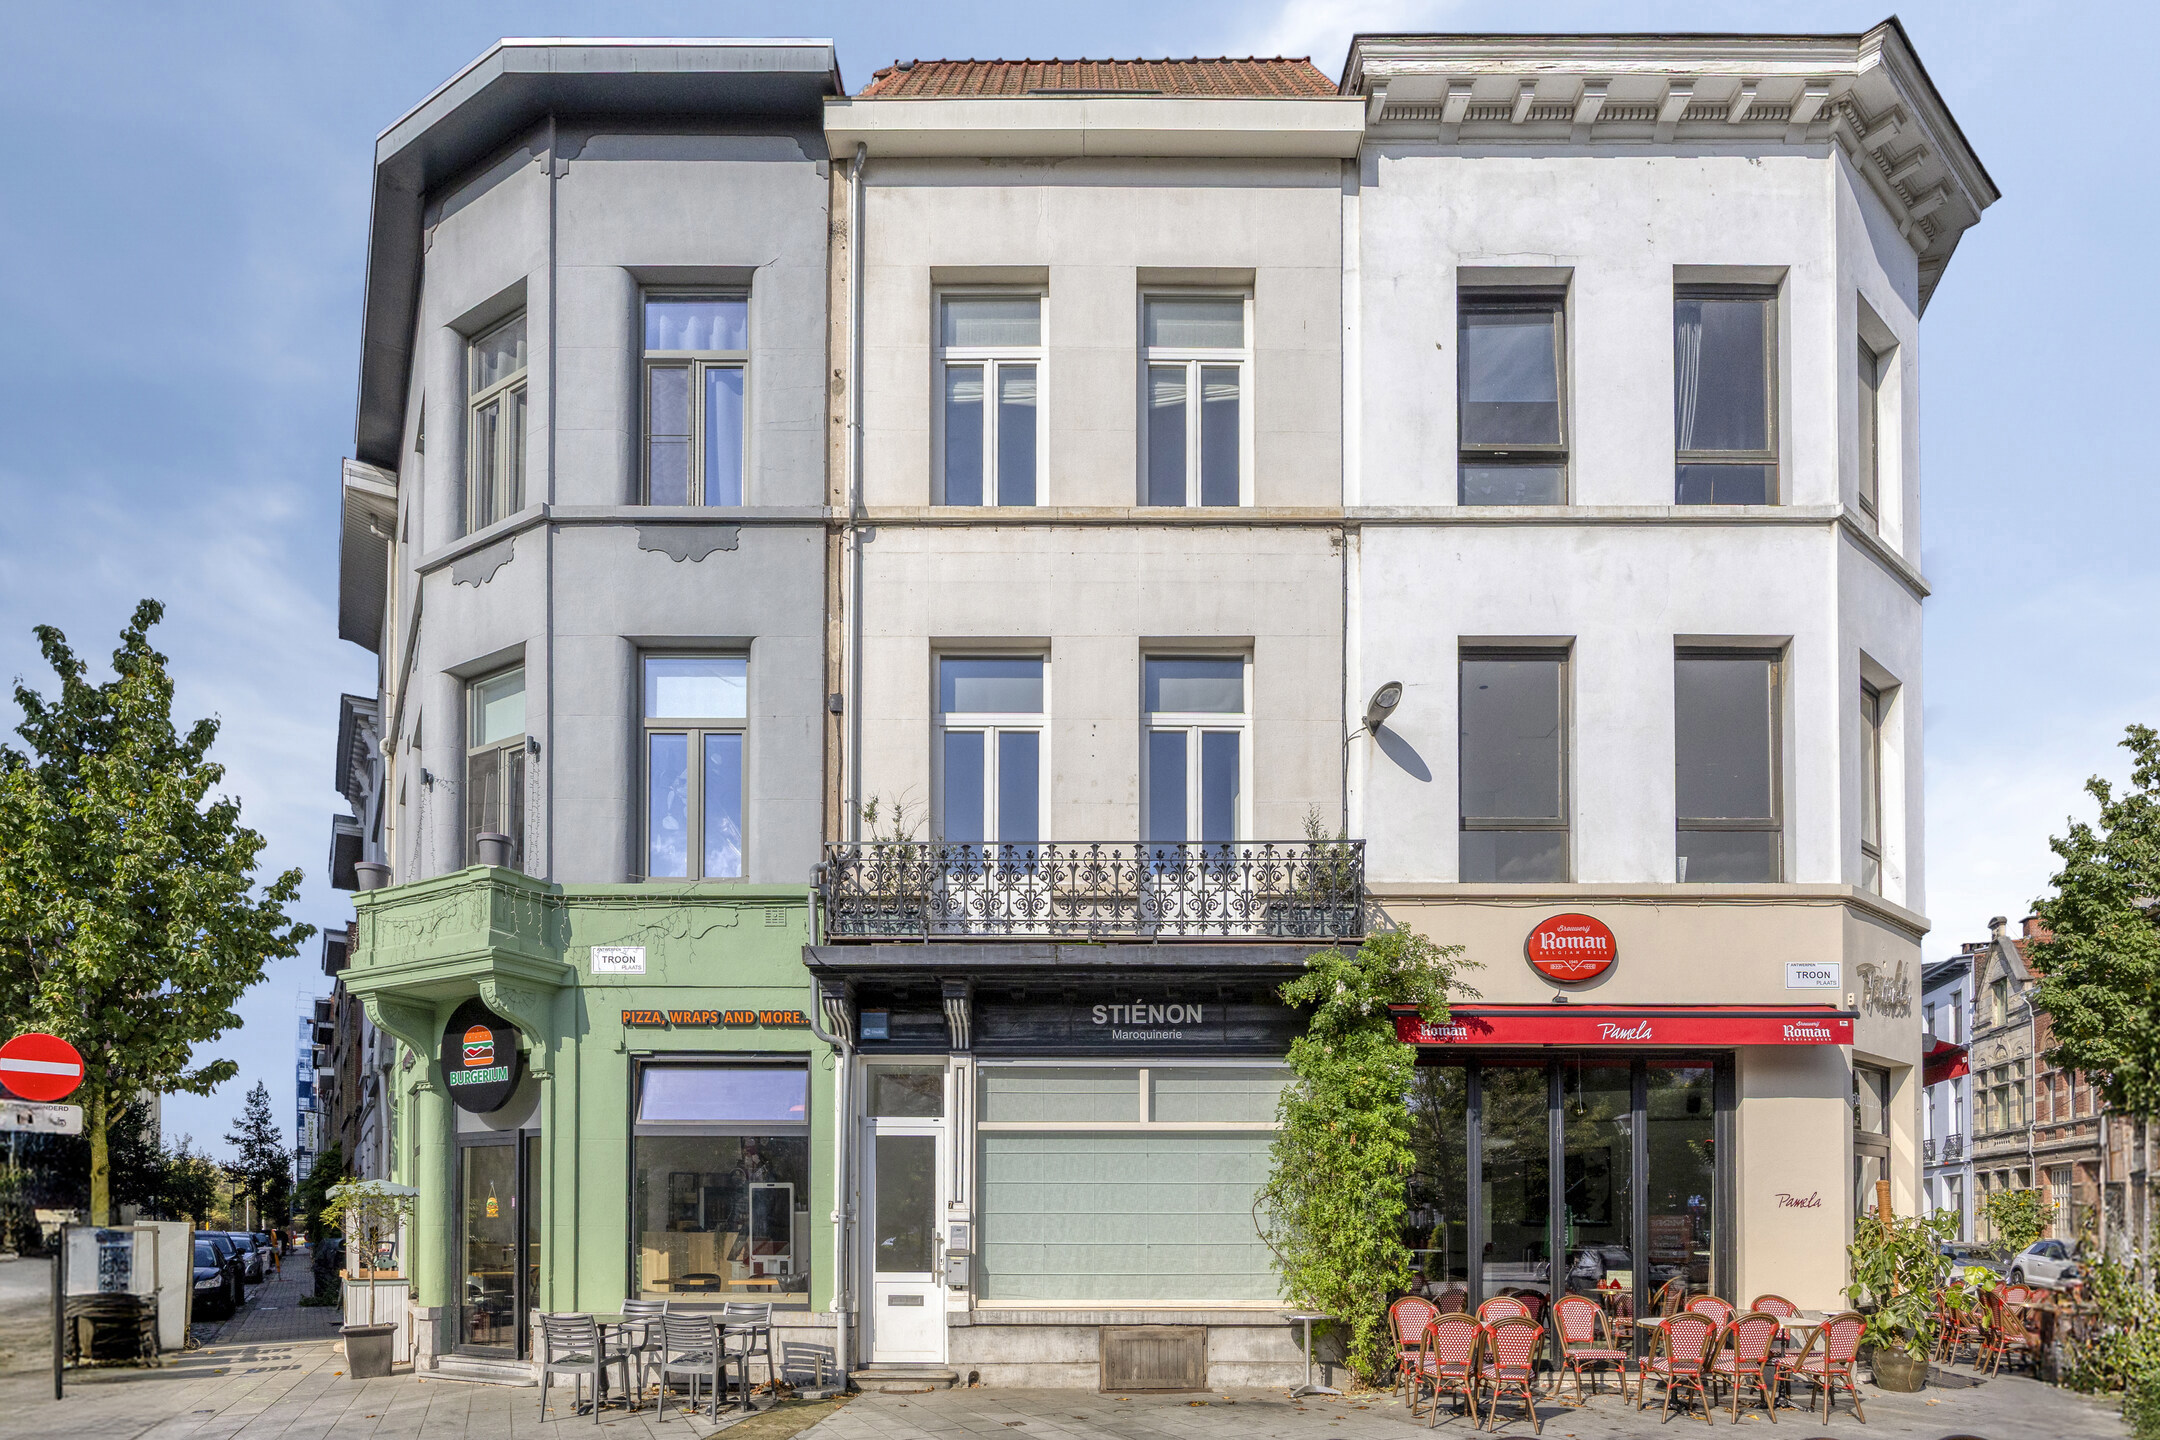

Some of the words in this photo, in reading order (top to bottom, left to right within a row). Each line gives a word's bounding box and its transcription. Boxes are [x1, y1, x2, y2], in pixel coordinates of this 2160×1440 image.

[1540, 932, 1607, 949] Roman
[602, 955, 636, 964] TROON
[1795, 970, 1831, 979] TROON
[622, 1011, 666, 1025] PIZZA,
[669, 1011, 719, 1024] WRAPS
[724, 1011, 755, 1024] AND
[1092, 998, 1203, 1024] STIÉNON
[1112, 1029, 1183, 1041] Maroquinerie
[1420, 1023, 1468, 1037] Roman
[1597, 1020, 1653, 1040] Pamela
[1783, 1024, 1831, 1038] Roman
[450, 1066, 509, 1086] BURGERIUM
[1775, 1191, 1822, 1209] Pamela
